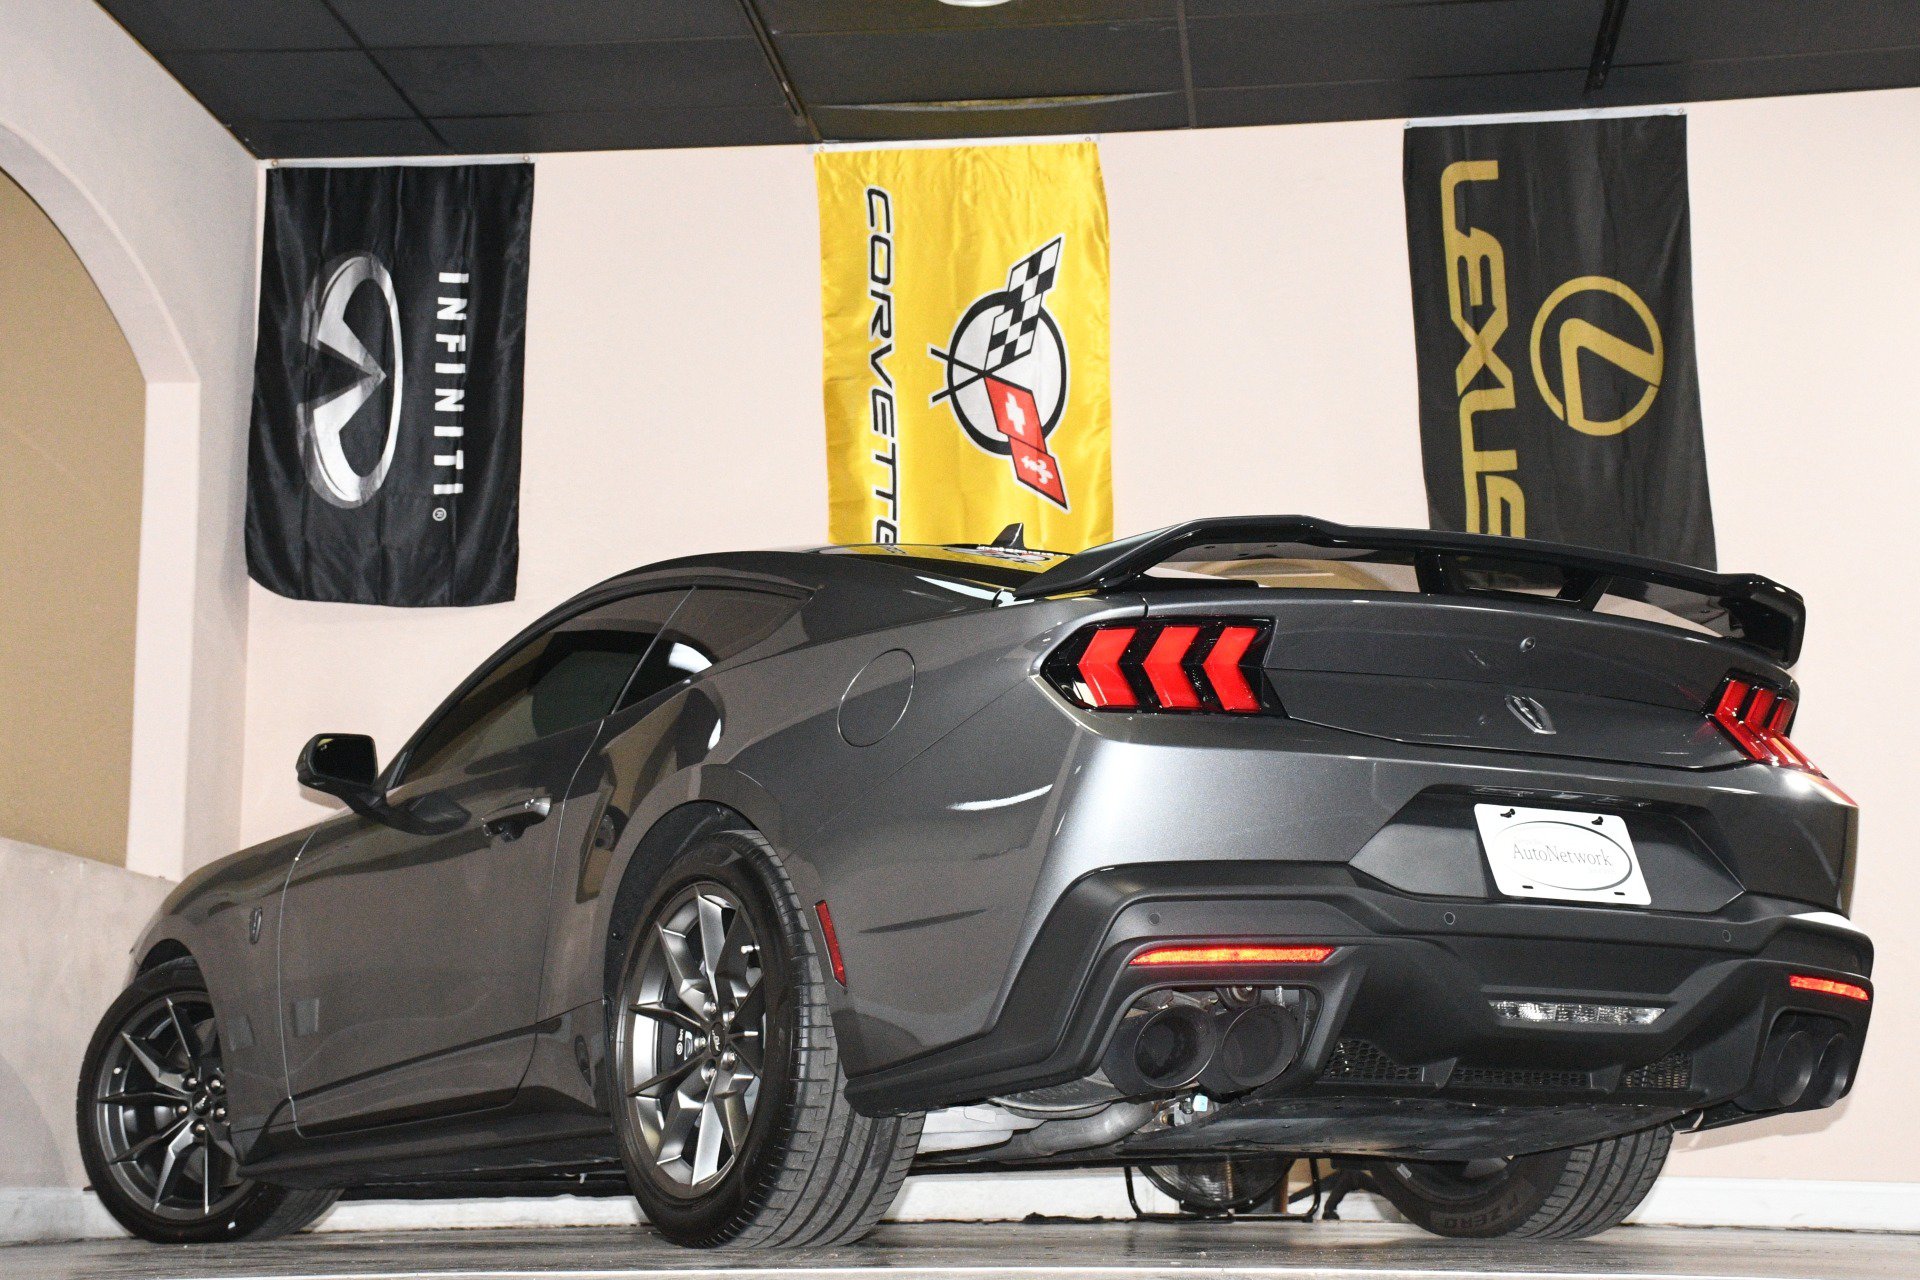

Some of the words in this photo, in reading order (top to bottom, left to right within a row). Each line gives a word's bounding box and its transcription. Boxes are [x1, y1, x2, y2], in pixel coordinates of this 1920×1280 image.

[433, 271, 469, 495] INFINITI
[1441, 160, 1526, 539] LEXUS
[1512, 843, 1612, 866] AutoNetwork
